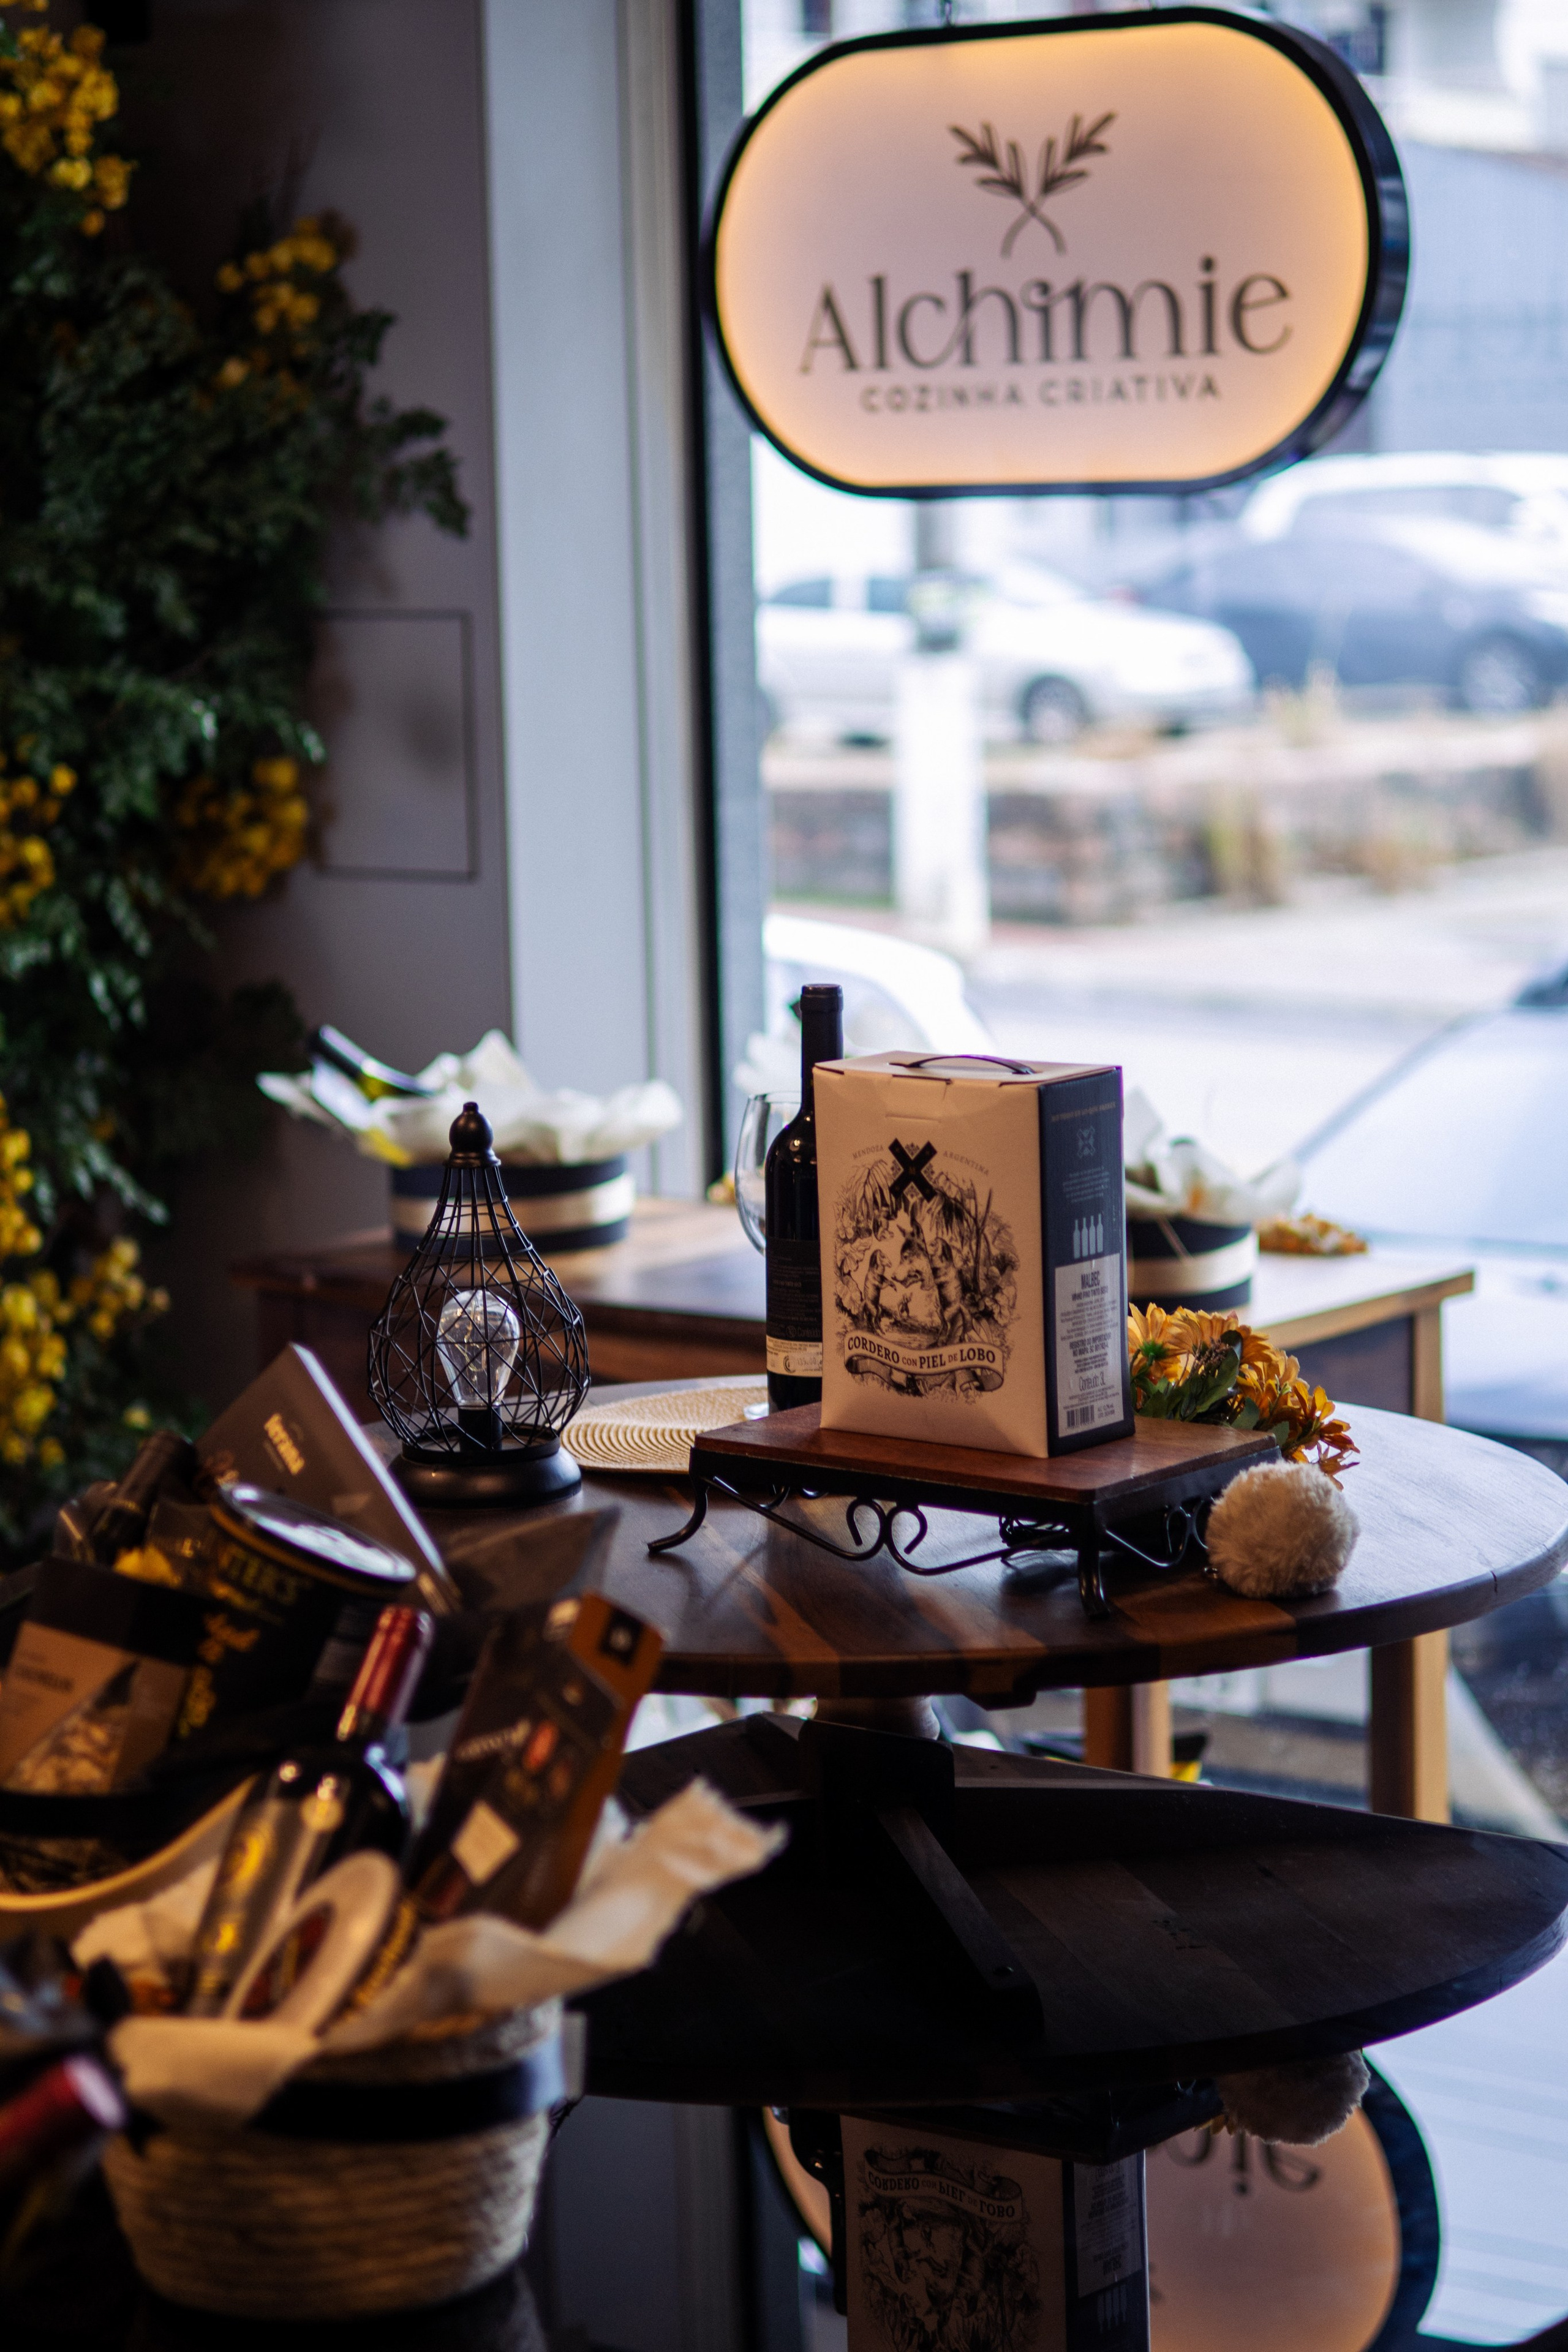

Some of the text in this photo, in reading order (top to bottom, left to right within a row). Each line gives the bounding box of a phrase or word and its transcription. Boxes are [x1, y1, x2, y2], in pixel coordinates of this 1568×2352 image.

[799, 253, 1294, 375] Alchimie
[861, 371, 1219, 414] COZINHA CRIATIVA
[852, 1144, 884, 1161] MENDOZA
[943, 1150, 990, 1177] ARGENTINA
[1080, 1270, 1100, 1290] MALBEC
[847, 1336, 996, 1370] CORDERO CON PIEL DE LOBO
